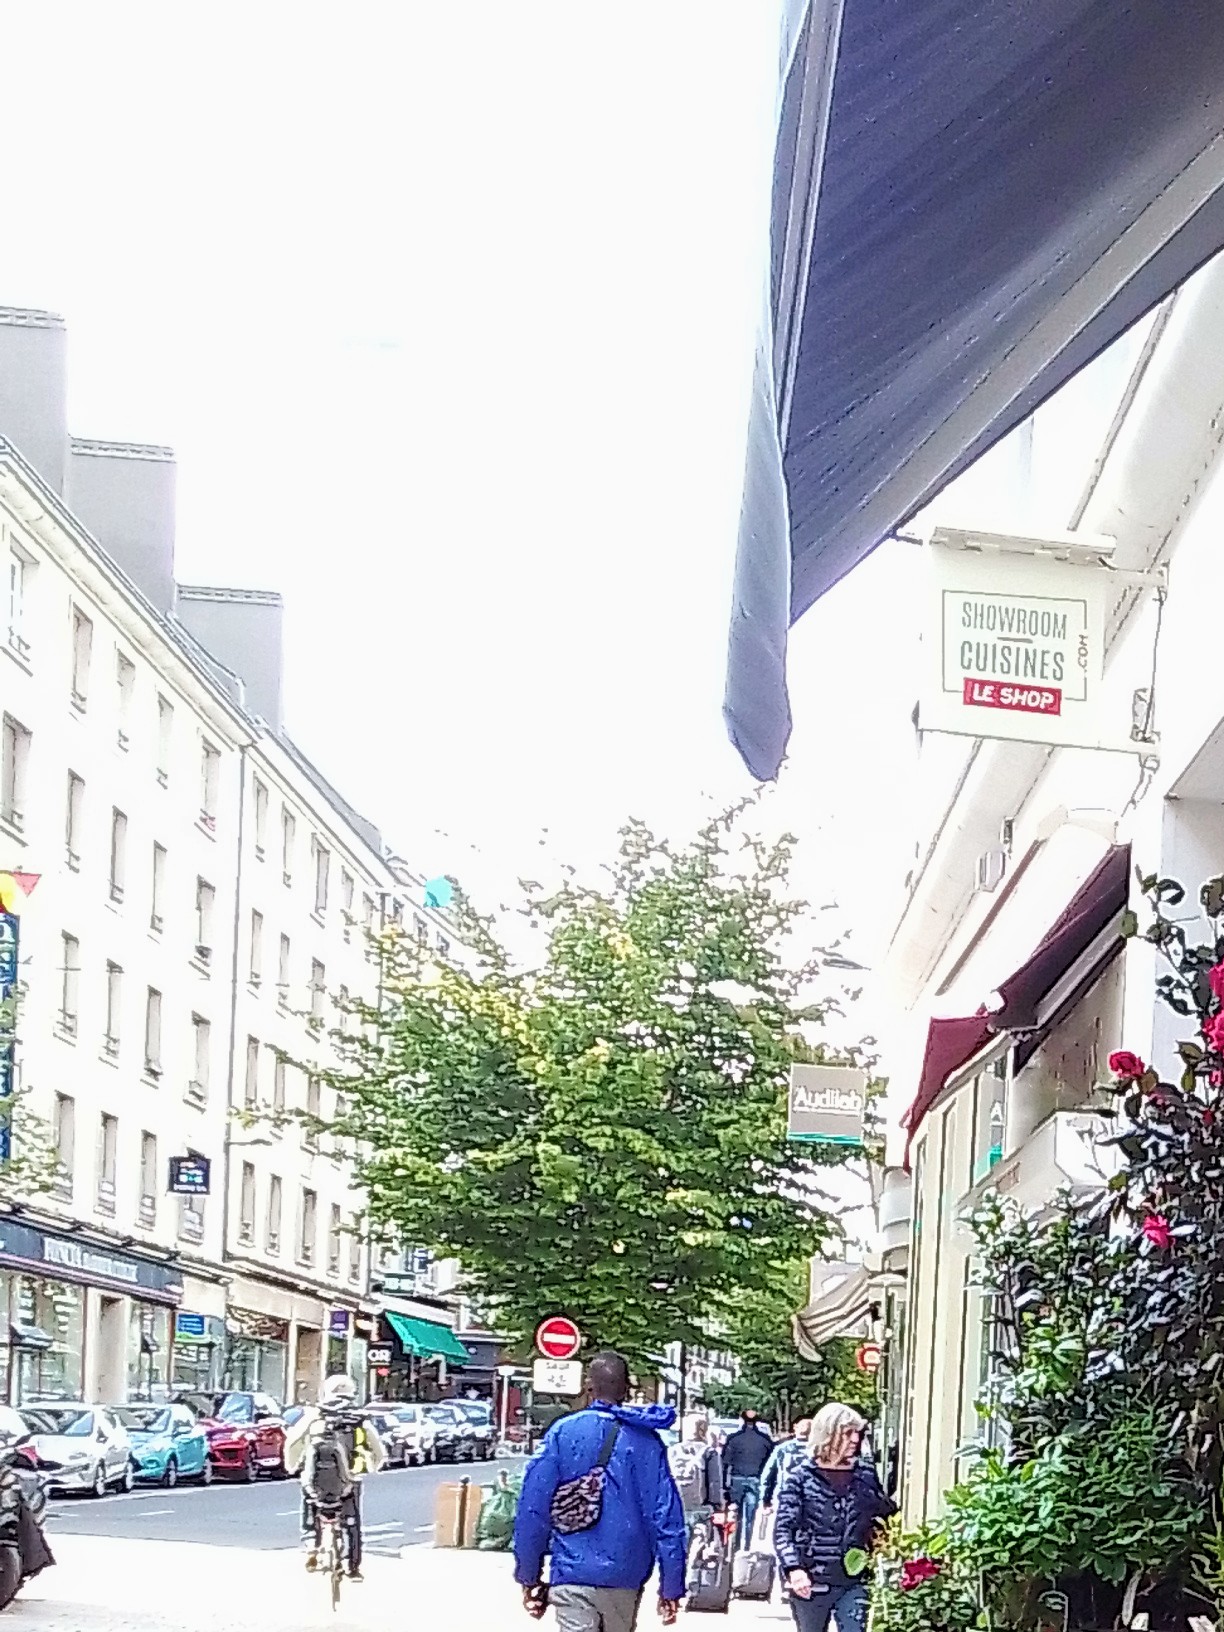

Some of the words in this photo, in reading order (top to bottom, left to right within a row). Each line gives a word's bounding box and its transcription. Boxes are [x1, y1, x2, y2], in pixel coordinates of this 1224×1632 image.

[961, 601, 1067, 640] SHOWROOM
[960, 641, 1065, 681] CUISINES
[972, 683, 995, 702] LE
[1000, 687, 1055, 709] SHOP
